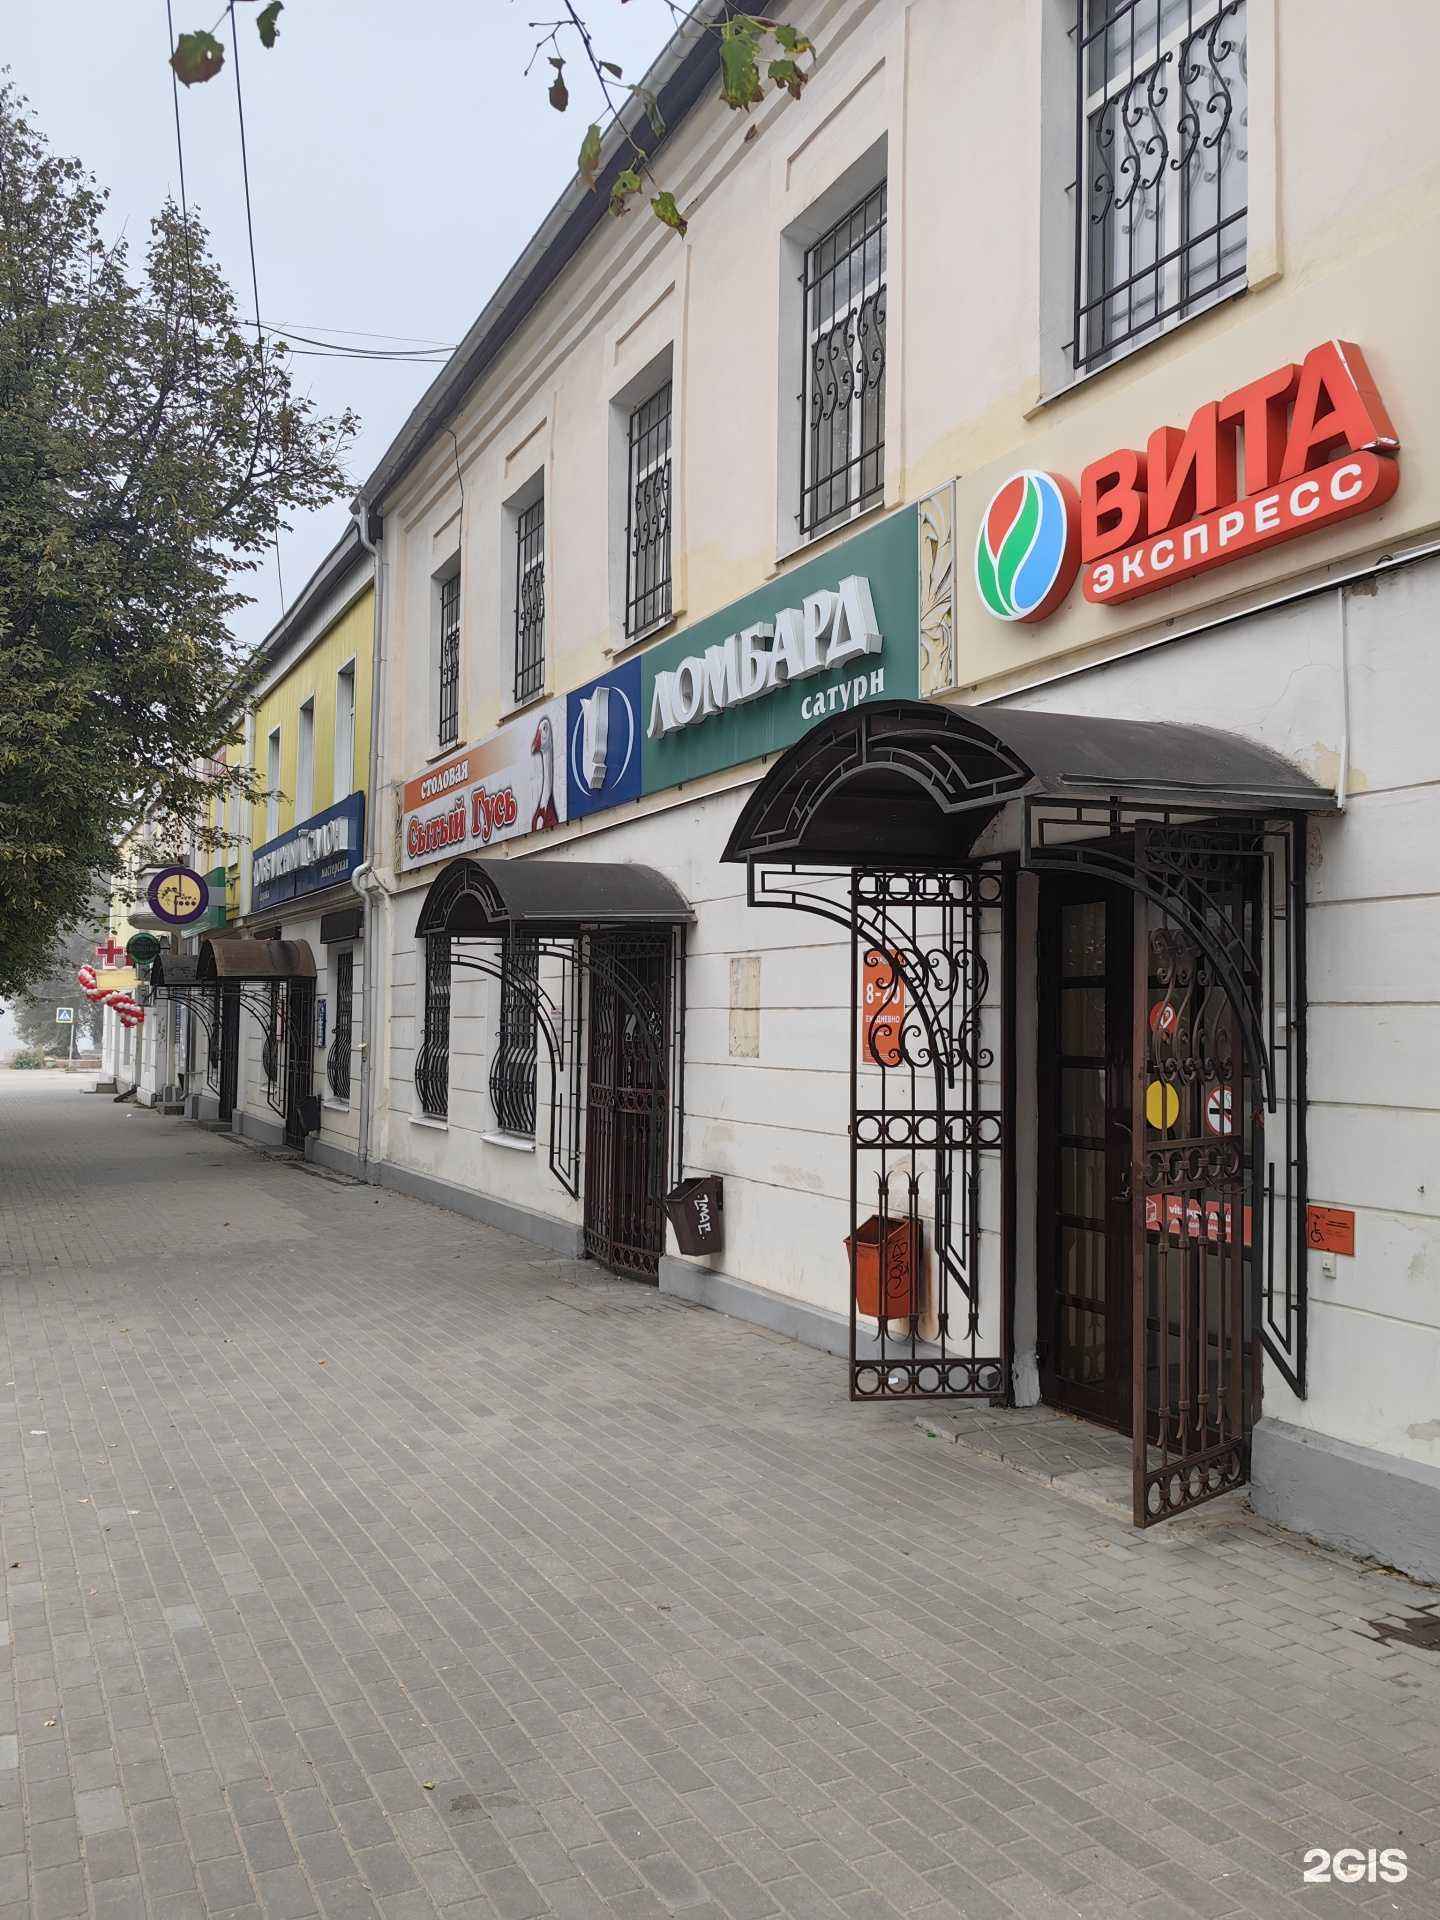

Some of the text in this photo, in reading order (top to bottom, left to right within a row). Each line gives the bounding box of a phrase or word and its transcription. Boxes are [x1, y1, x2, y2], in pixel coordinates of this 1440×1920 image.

[1080, 339, 1390, 564] ВИТА
[1092, 462, 1363, 595] ЭКСПРЕСС
[647, 575, 884, 739] ЛОМБАРД
[801, 667, 885, 720] сатурн
[407, 786, 517, 860] Сытый Гусь
